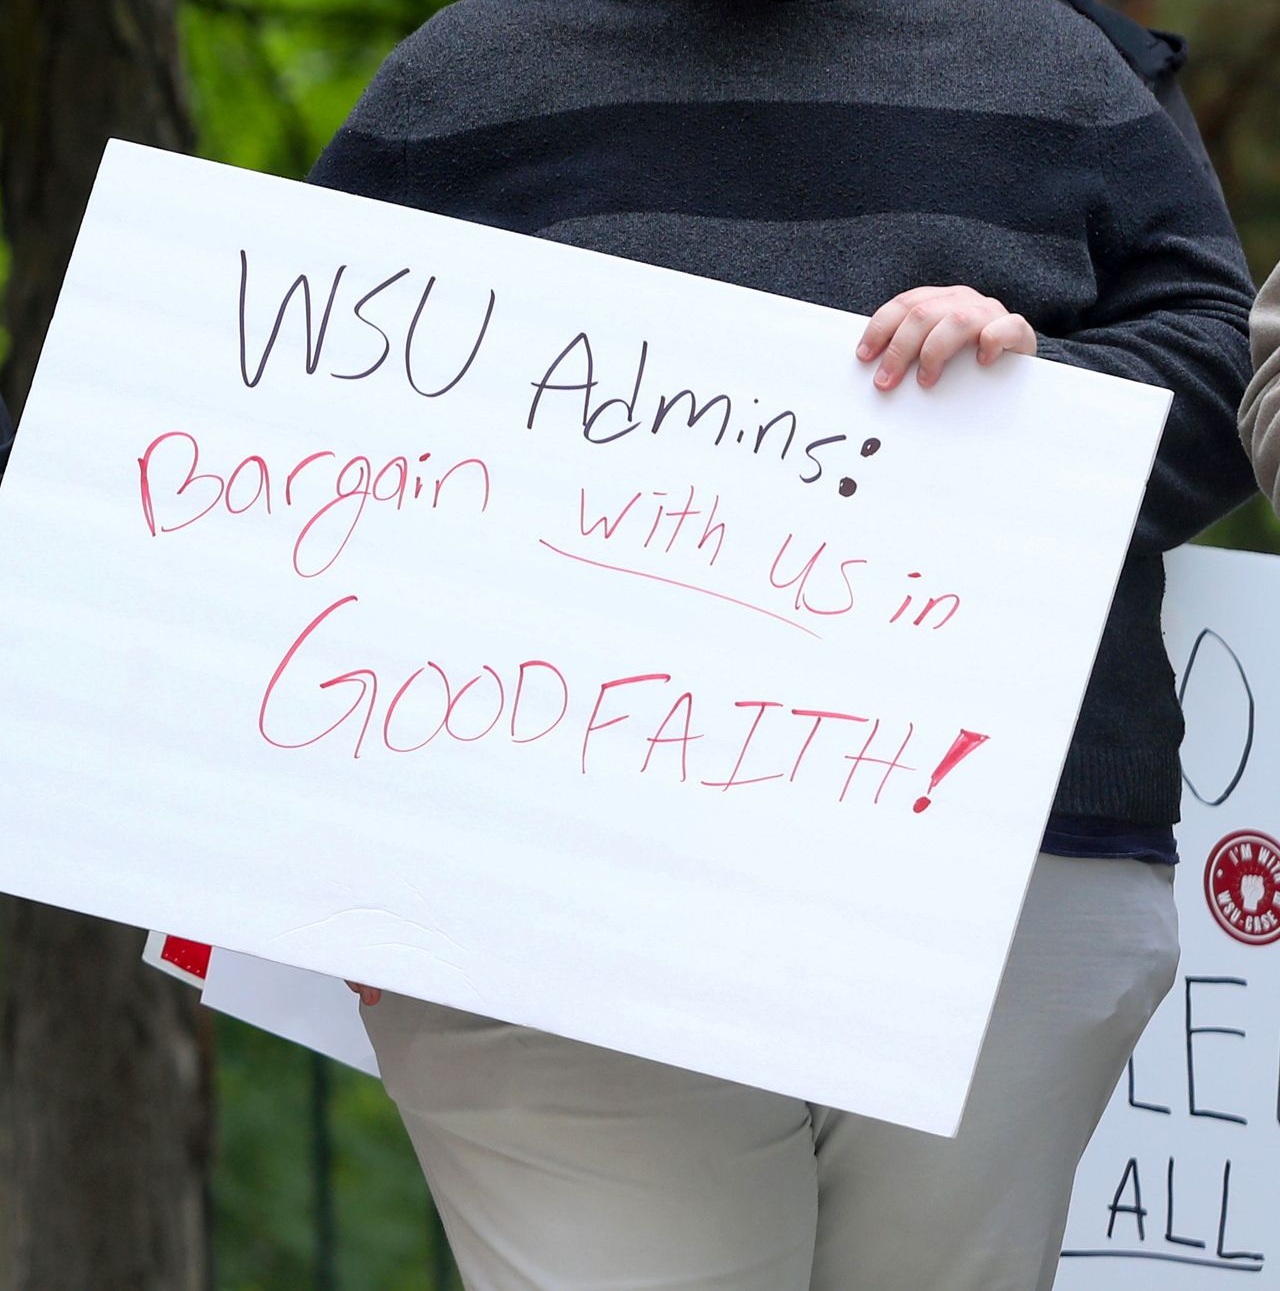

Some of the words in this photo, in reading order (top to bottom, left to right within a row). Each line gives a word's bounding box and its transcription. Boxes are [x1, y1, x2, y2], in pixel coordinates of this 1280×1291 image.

[239, 250, 495, 398] WSU
[526, 332, 882, 498] Admins:
[137, 430, 490, 578] Bargain
[576, 485, 726, 568] with
[890, 572, 960, 630] in
[259, 595, 569, 761] GOOD
[582, 672, 991, 814] FAITH!
[1108, 1156, 1265, 1260] ALL
